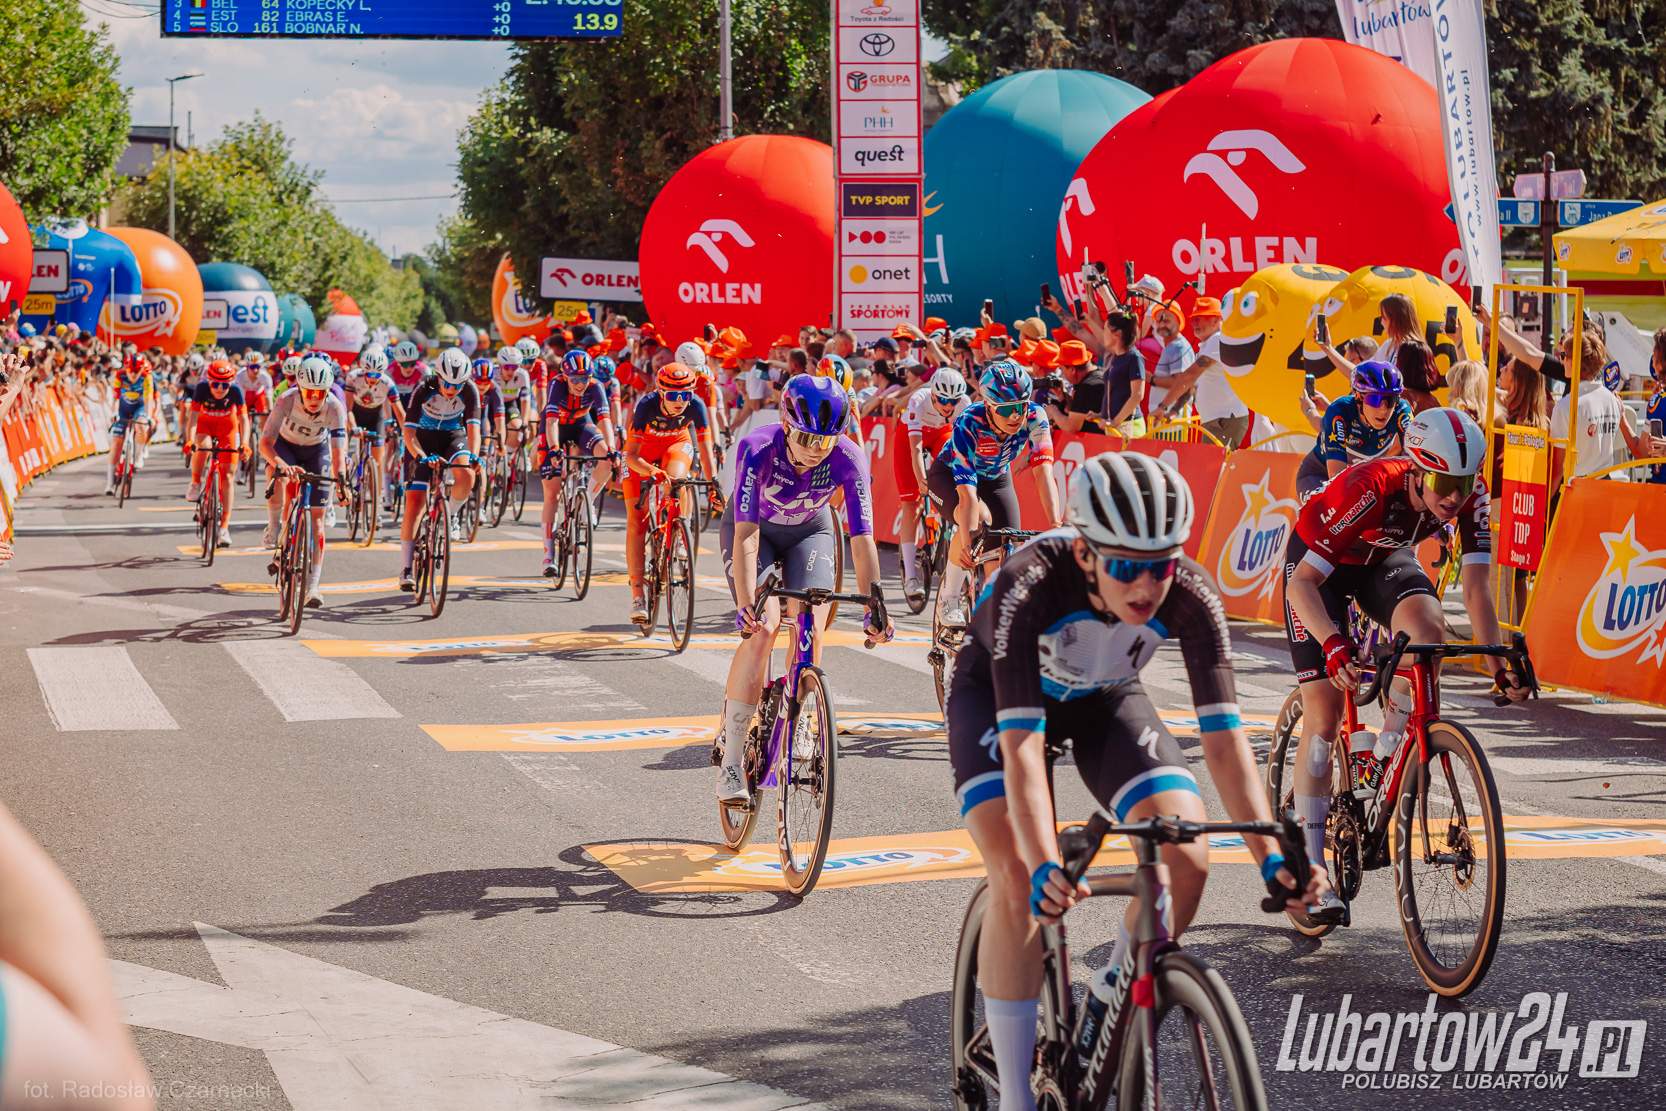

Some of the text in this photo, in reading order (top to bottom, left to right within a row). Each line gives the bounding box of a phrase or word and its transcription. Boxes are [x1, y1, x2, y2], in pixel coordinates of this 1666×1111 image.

[211, 0, 238, 8] BEL
[286, 0, 354, 10] KOPECKY
[493, 2, 511, 12] +0
[173, 10, 618, 31] 4 EST 82 EBRAS E. +0 13.9
[173, 22, 510, 36] 5 SLO 161 BOBNAR N. +0
[870, 75, 911, 84] GRUPA
[855, 145, 904, 166] quest
[850, 195, 911, 206] TVP SPORT
[1172, 236, 1318, 275] ORLEN
[581, 272, 639, 288] ORLEN
[872, 267, 911, 280] onet
[678, 281, 762, 304] ORLEN
[25, 299, 52, 311] 25m
[119, 301, 167, 323] LOTTO
[227, 295, 269, 325] est
[740, 467, 757, 513] Jayco
[773, 473, 794, 486] Jayco
[1512, 491, 1535, 517] CLUB
[1514, 521, 1531, 545] TDP
[1237, 517, 1286, 571] LOTTO
[1526, 553, 1531, 564] 2
[1603, 579, 1666, 631] LOTTO
